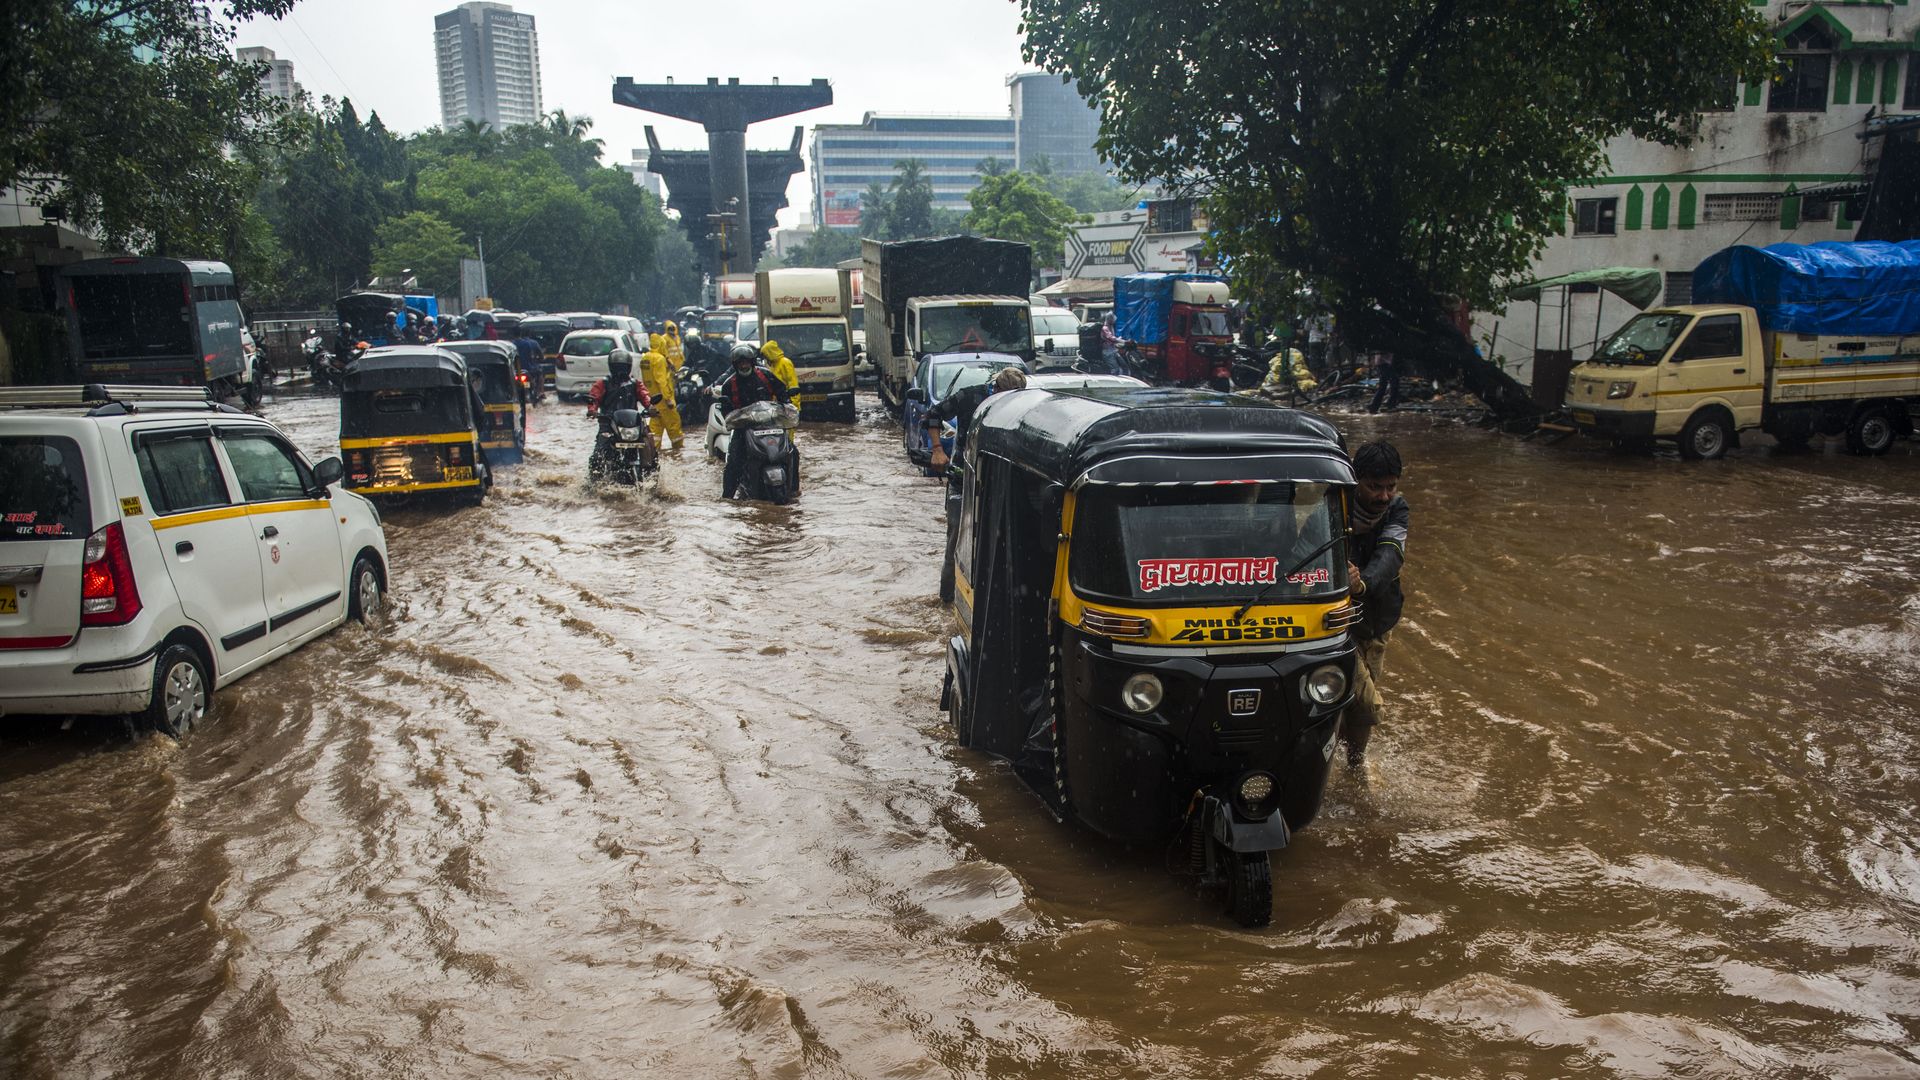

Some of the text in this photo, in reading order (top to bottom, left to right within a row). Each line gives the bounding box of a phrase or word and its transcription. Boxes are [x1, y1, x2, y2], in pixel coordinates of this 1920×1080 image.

[1094, 256, 1126, 265] RESTAURANT
[1138, 557, 1279, 592] द्वारकानाथ
[1170, 625, 1306, 642] 4030
[1233, 697, 1255, 710] RE
